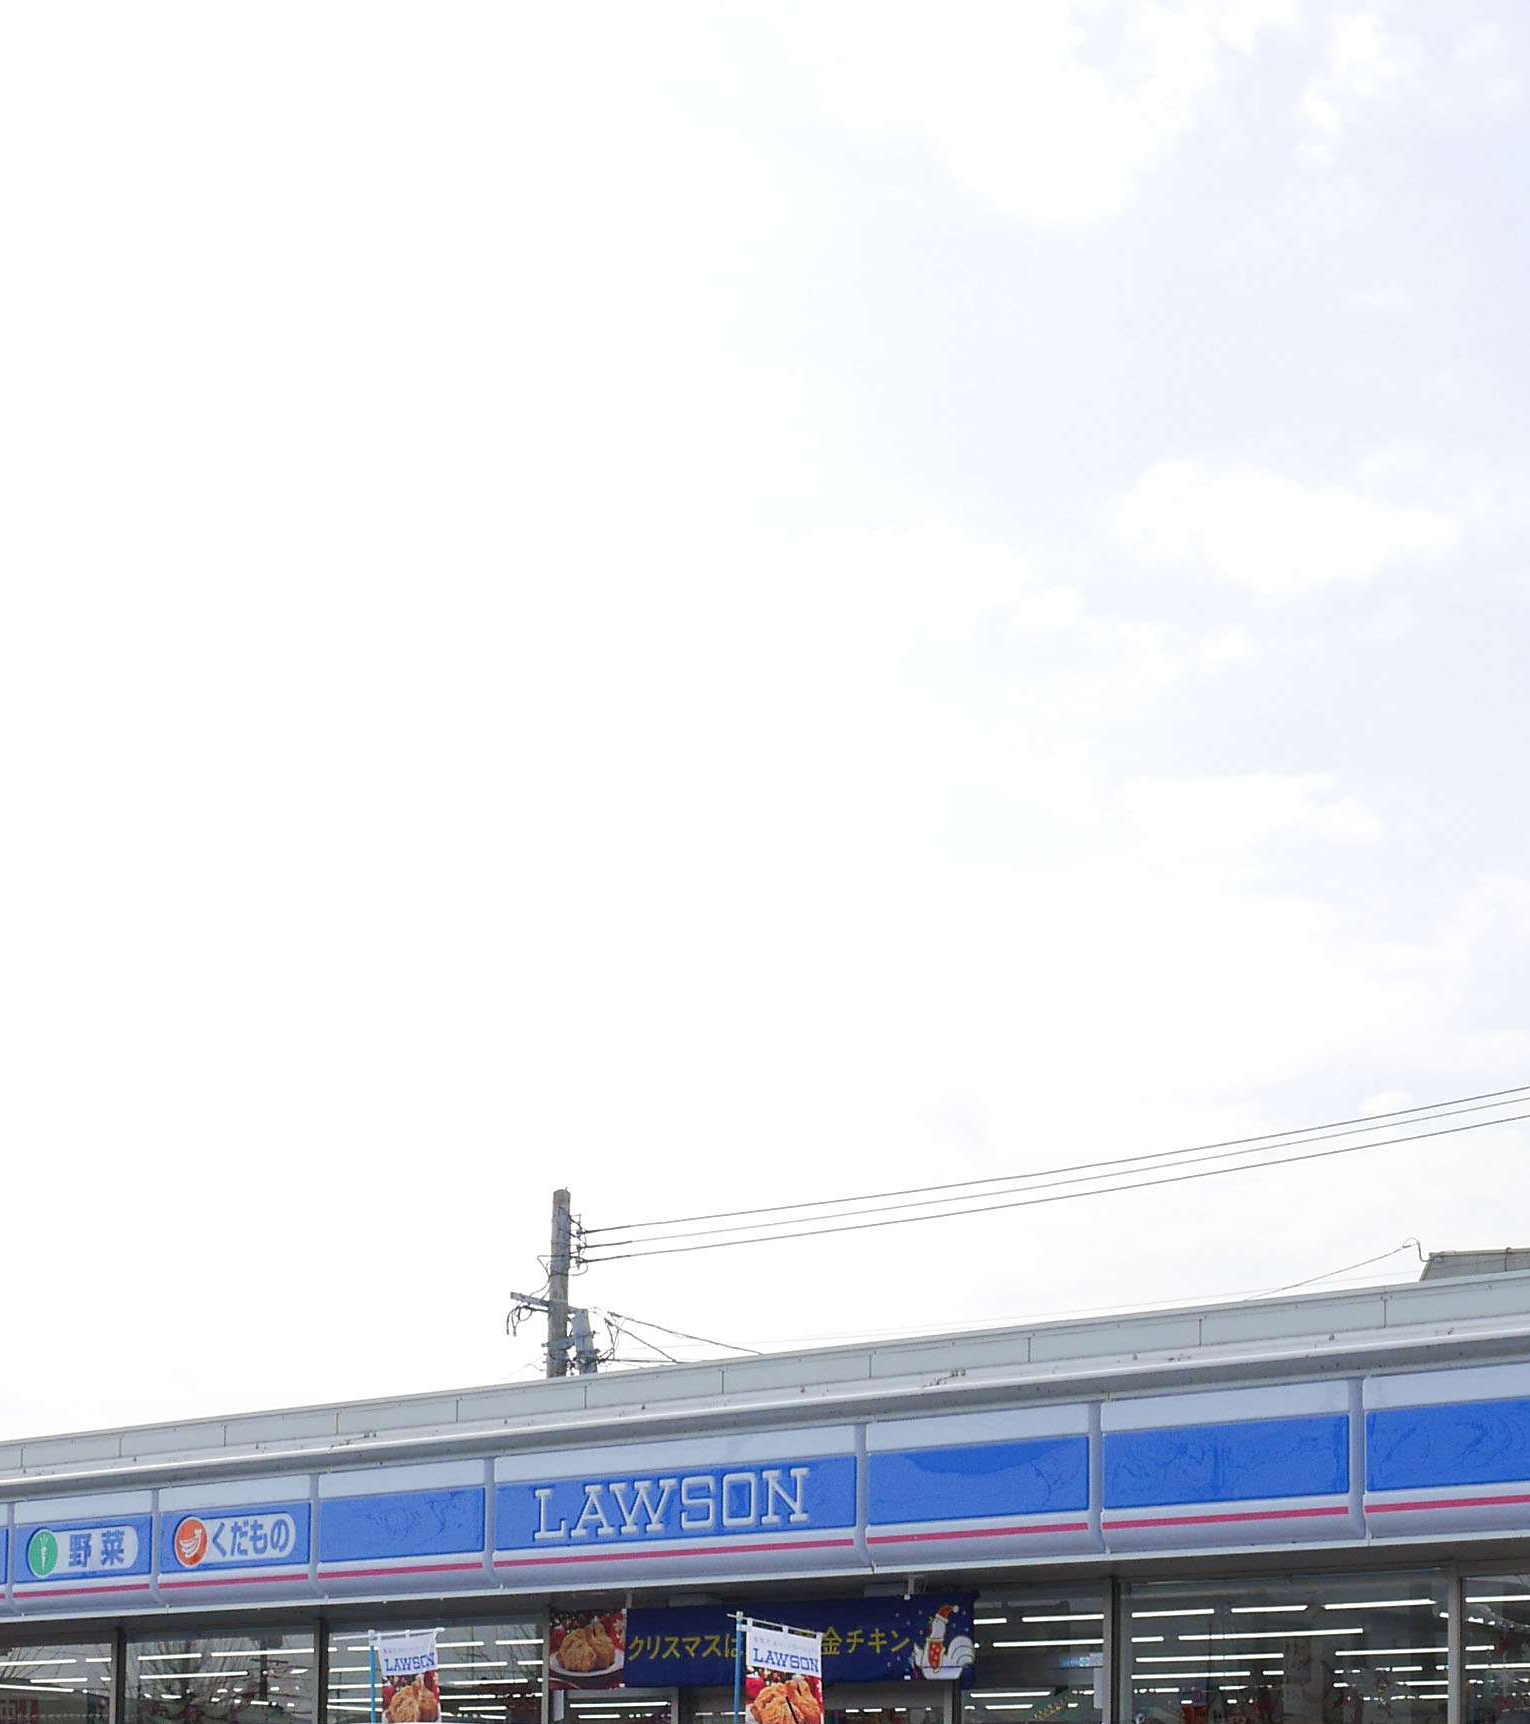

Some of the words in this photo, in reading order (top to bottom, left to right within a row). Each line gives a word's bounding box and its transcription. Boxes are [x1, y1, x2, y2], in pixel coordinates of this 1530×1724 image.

[533, 1466, 810, 1541] LAWSON
[68, 1530, 125, 1568] 野菜
[211, 1518, 290, 1559] くだもの
[384, 1652, 436, 1672] LAWSON
[752, 1647, 820, 1673] LAWSON
